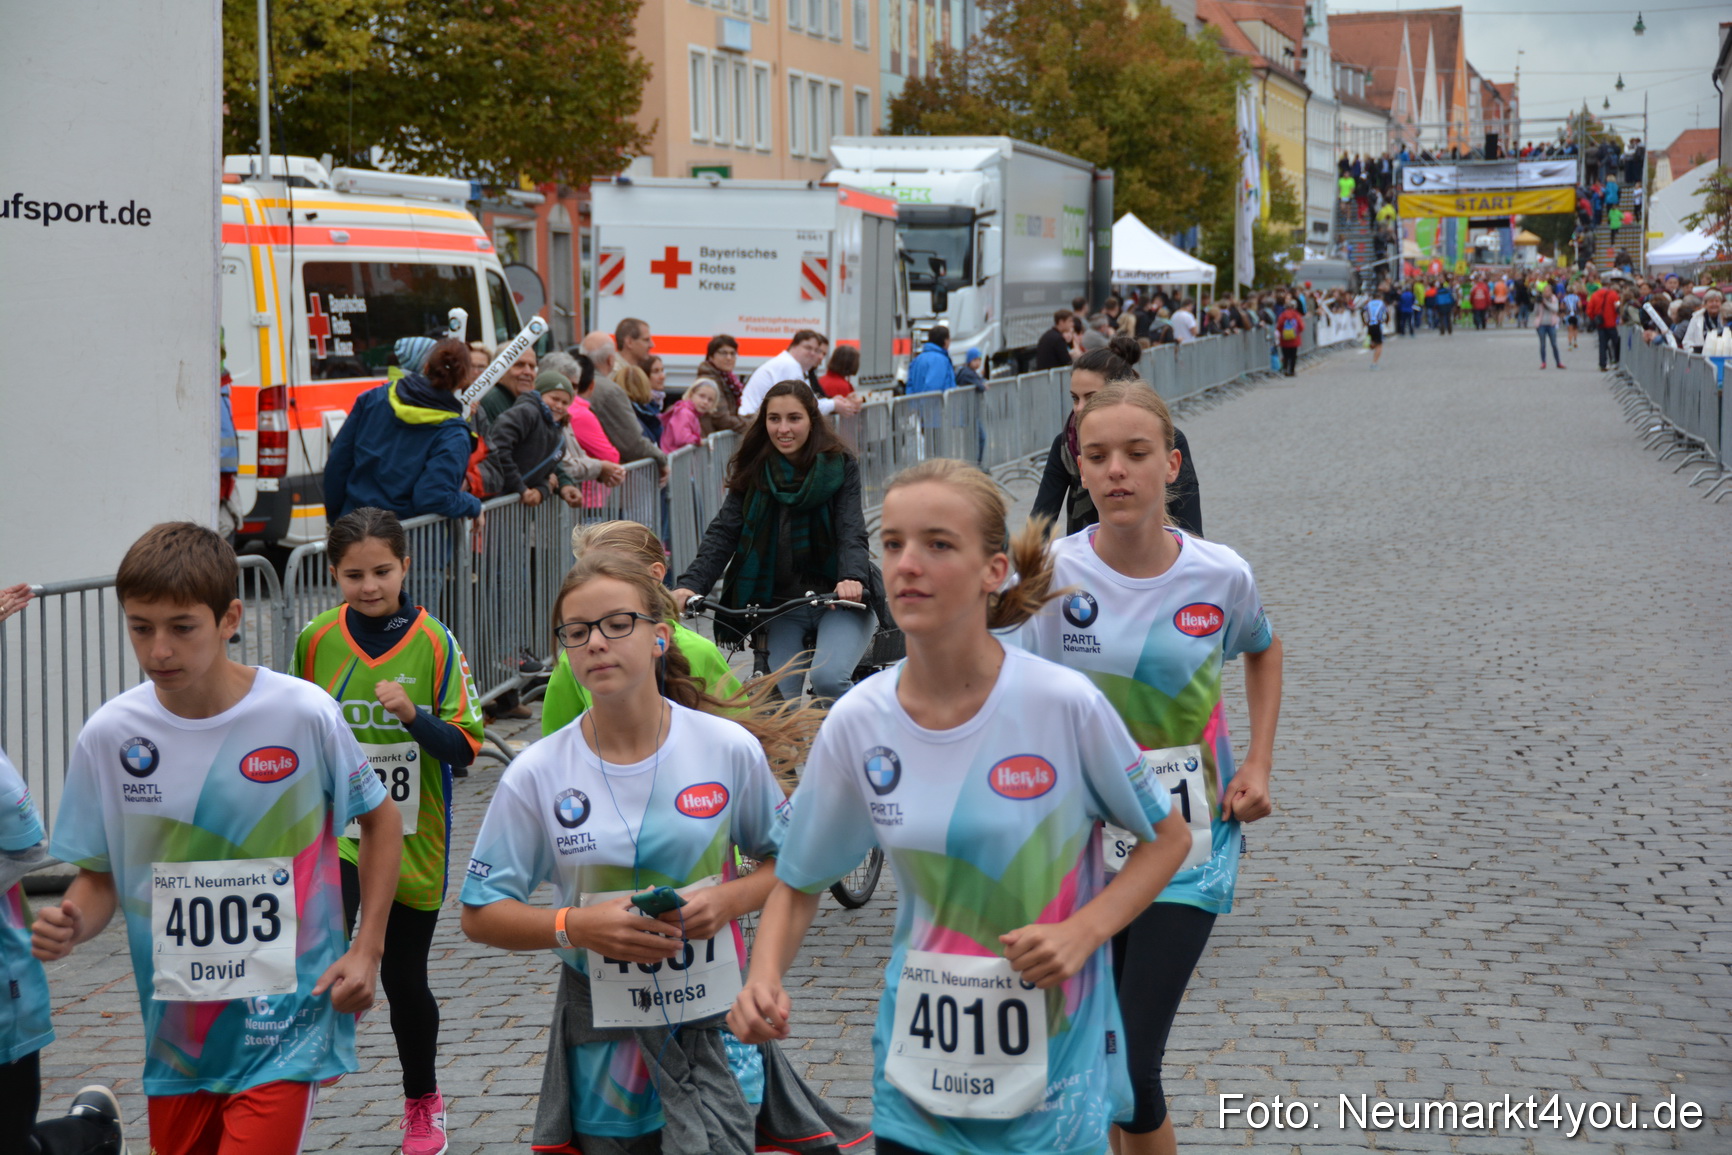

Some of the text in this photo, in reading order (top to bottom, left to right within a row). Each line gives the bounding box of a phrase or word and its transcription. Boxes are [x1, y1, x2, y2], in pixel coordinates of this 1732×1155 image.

[1456, 196, 1516, 212] START
[700, 247, 778, 260] Bayerisches
[700, 264, 736, 274] Rotes
[1117, 270, 1171, 280] Laufsport
[699, 280, 736, 291] Kreuz
[460, 336, 529, 405] BMW Laufsport
[1181, 612, 1219, 628] Hervis
[1063, 634, 1100, 646] PARTL
[1064, 645, 1101, 654] Neumarkt
[248, 756, 293, 774] Hervis
[998, 767, 1050, 788] Hervis
[123, 784, 162, 795] PARTL
[124, 795, 162, 803] Neumarkt
[682, 790, 724, 808] Hervis
[870, 802, 904, 816] PARTL
[556, 832, 596, 848] PARTL
[559, 843, 597, 856] Neumarkt
[155, 874, 266, 888] PARTL Neumarkt
[166, 893, 281, 947] 4003
[191, 959, 245, 981] David
[901, 966, 1012, 989] PARTL Neumarkt
[242, 996, 275, 1015] 16.
[909, 993, 1030, 1056] 4010
[932, 1068, 994, 1095] Louisa
